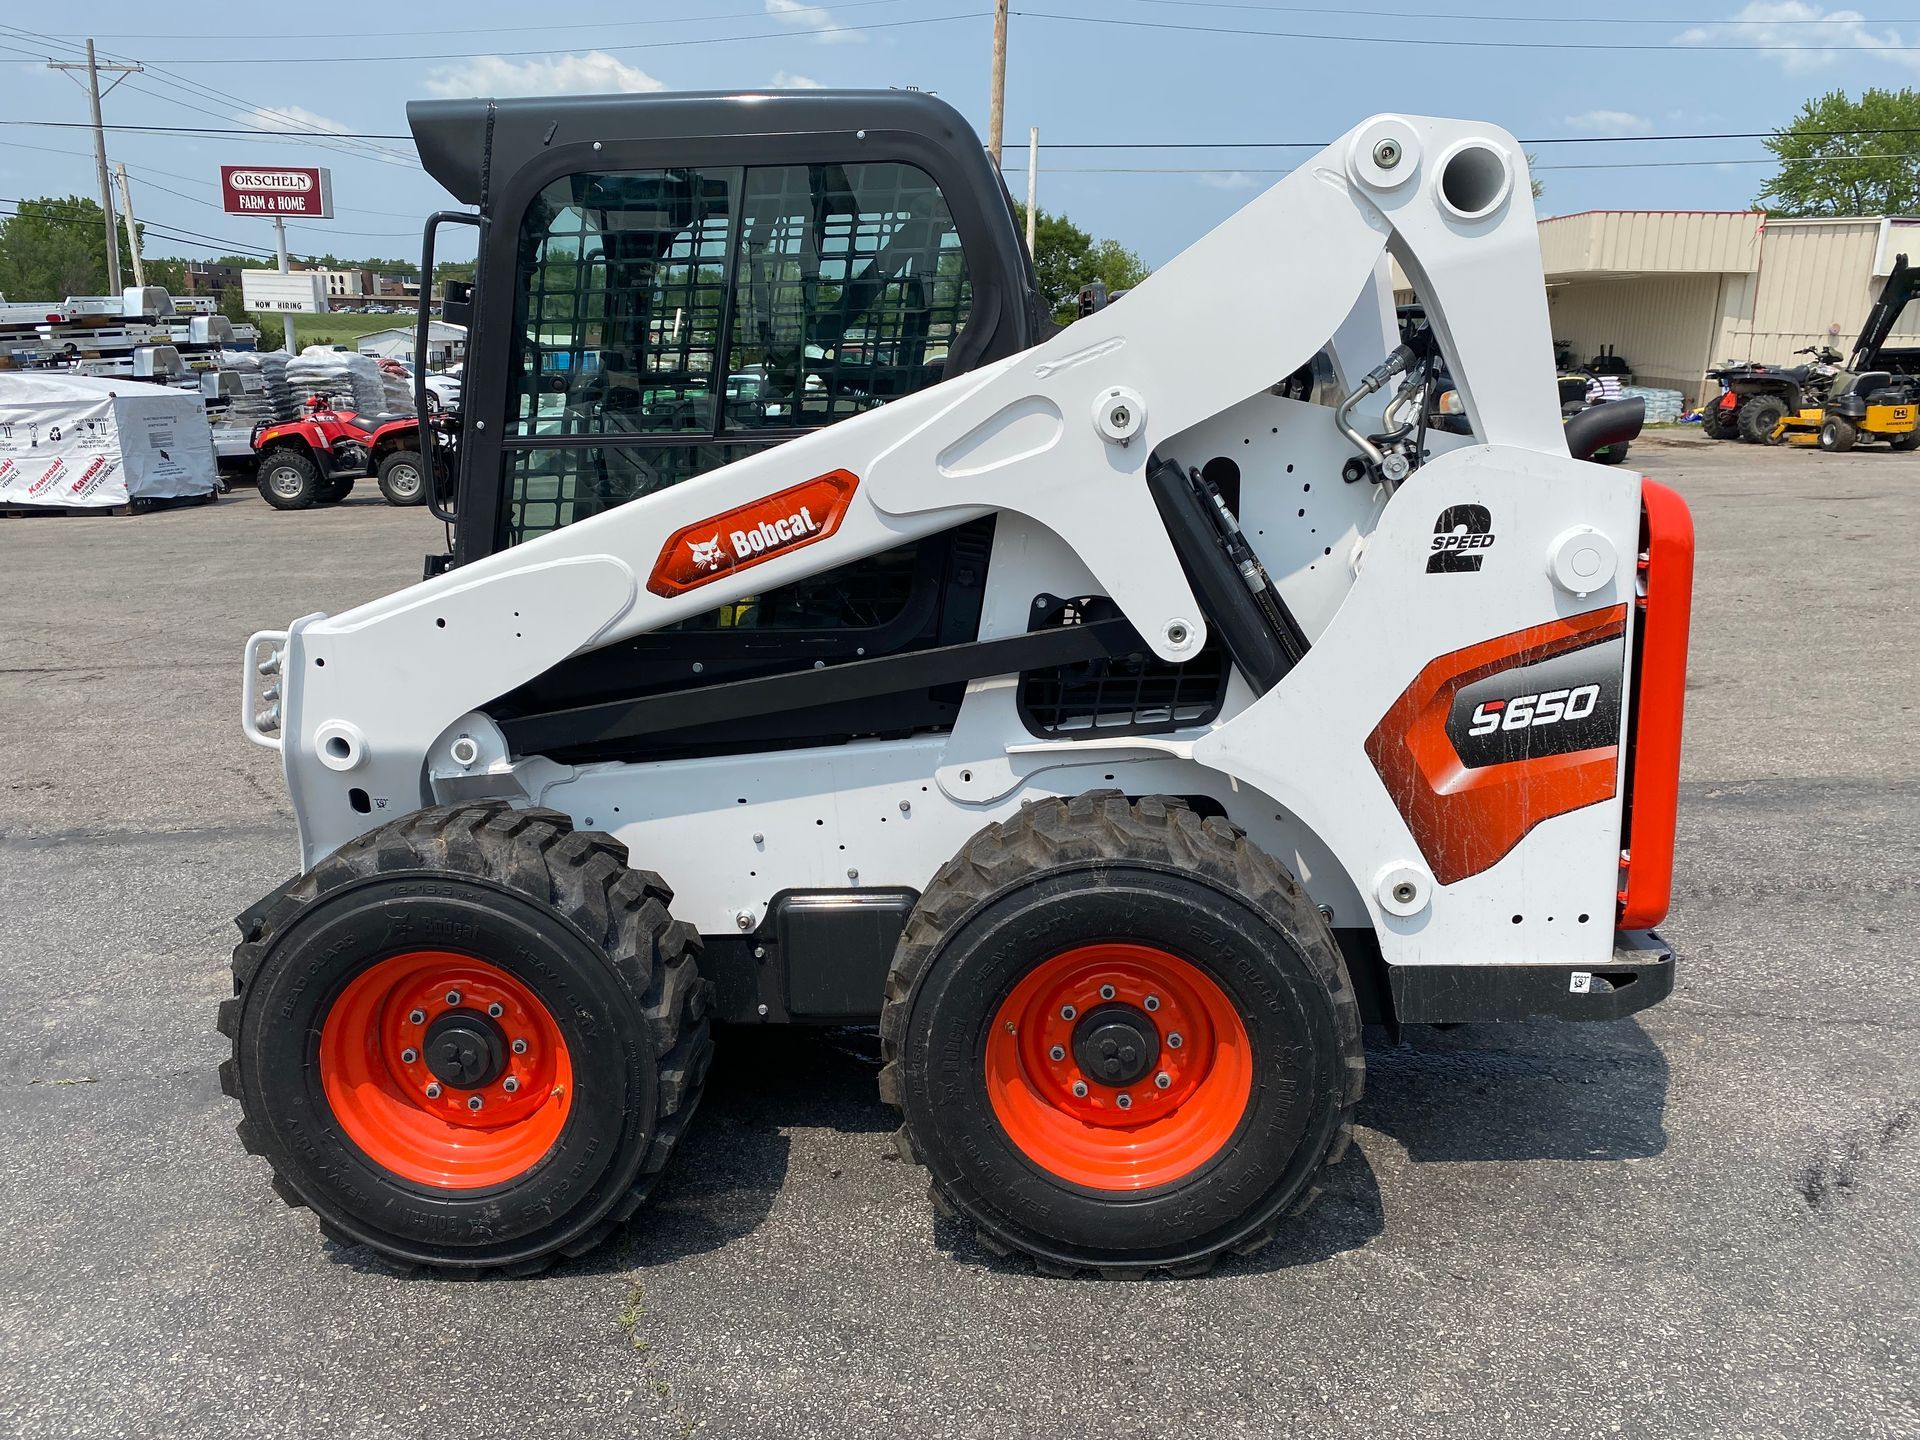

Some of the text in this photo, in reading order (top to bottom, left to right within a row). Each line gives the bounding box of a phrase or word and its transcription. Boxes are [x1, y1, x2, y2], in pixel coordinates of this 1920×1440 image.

[234, 174, 306, 190] ORSCHELN
[239, 195, 306, 210] FARM & HOME
[277, 302, 302, 310] HIRING
[28, 456, 64, 494] Kawasaki
[71, 454, 106, 492] Kawasaki
[81, 464, 115, 500] UTILITY VEHICLE
[729, 506, 816, 558] Bobcat
[1424, 504, 1492, 574] 2
[1430, 534, 1496, 551] SPEED
[1468, 684, 1600, 737] S650
